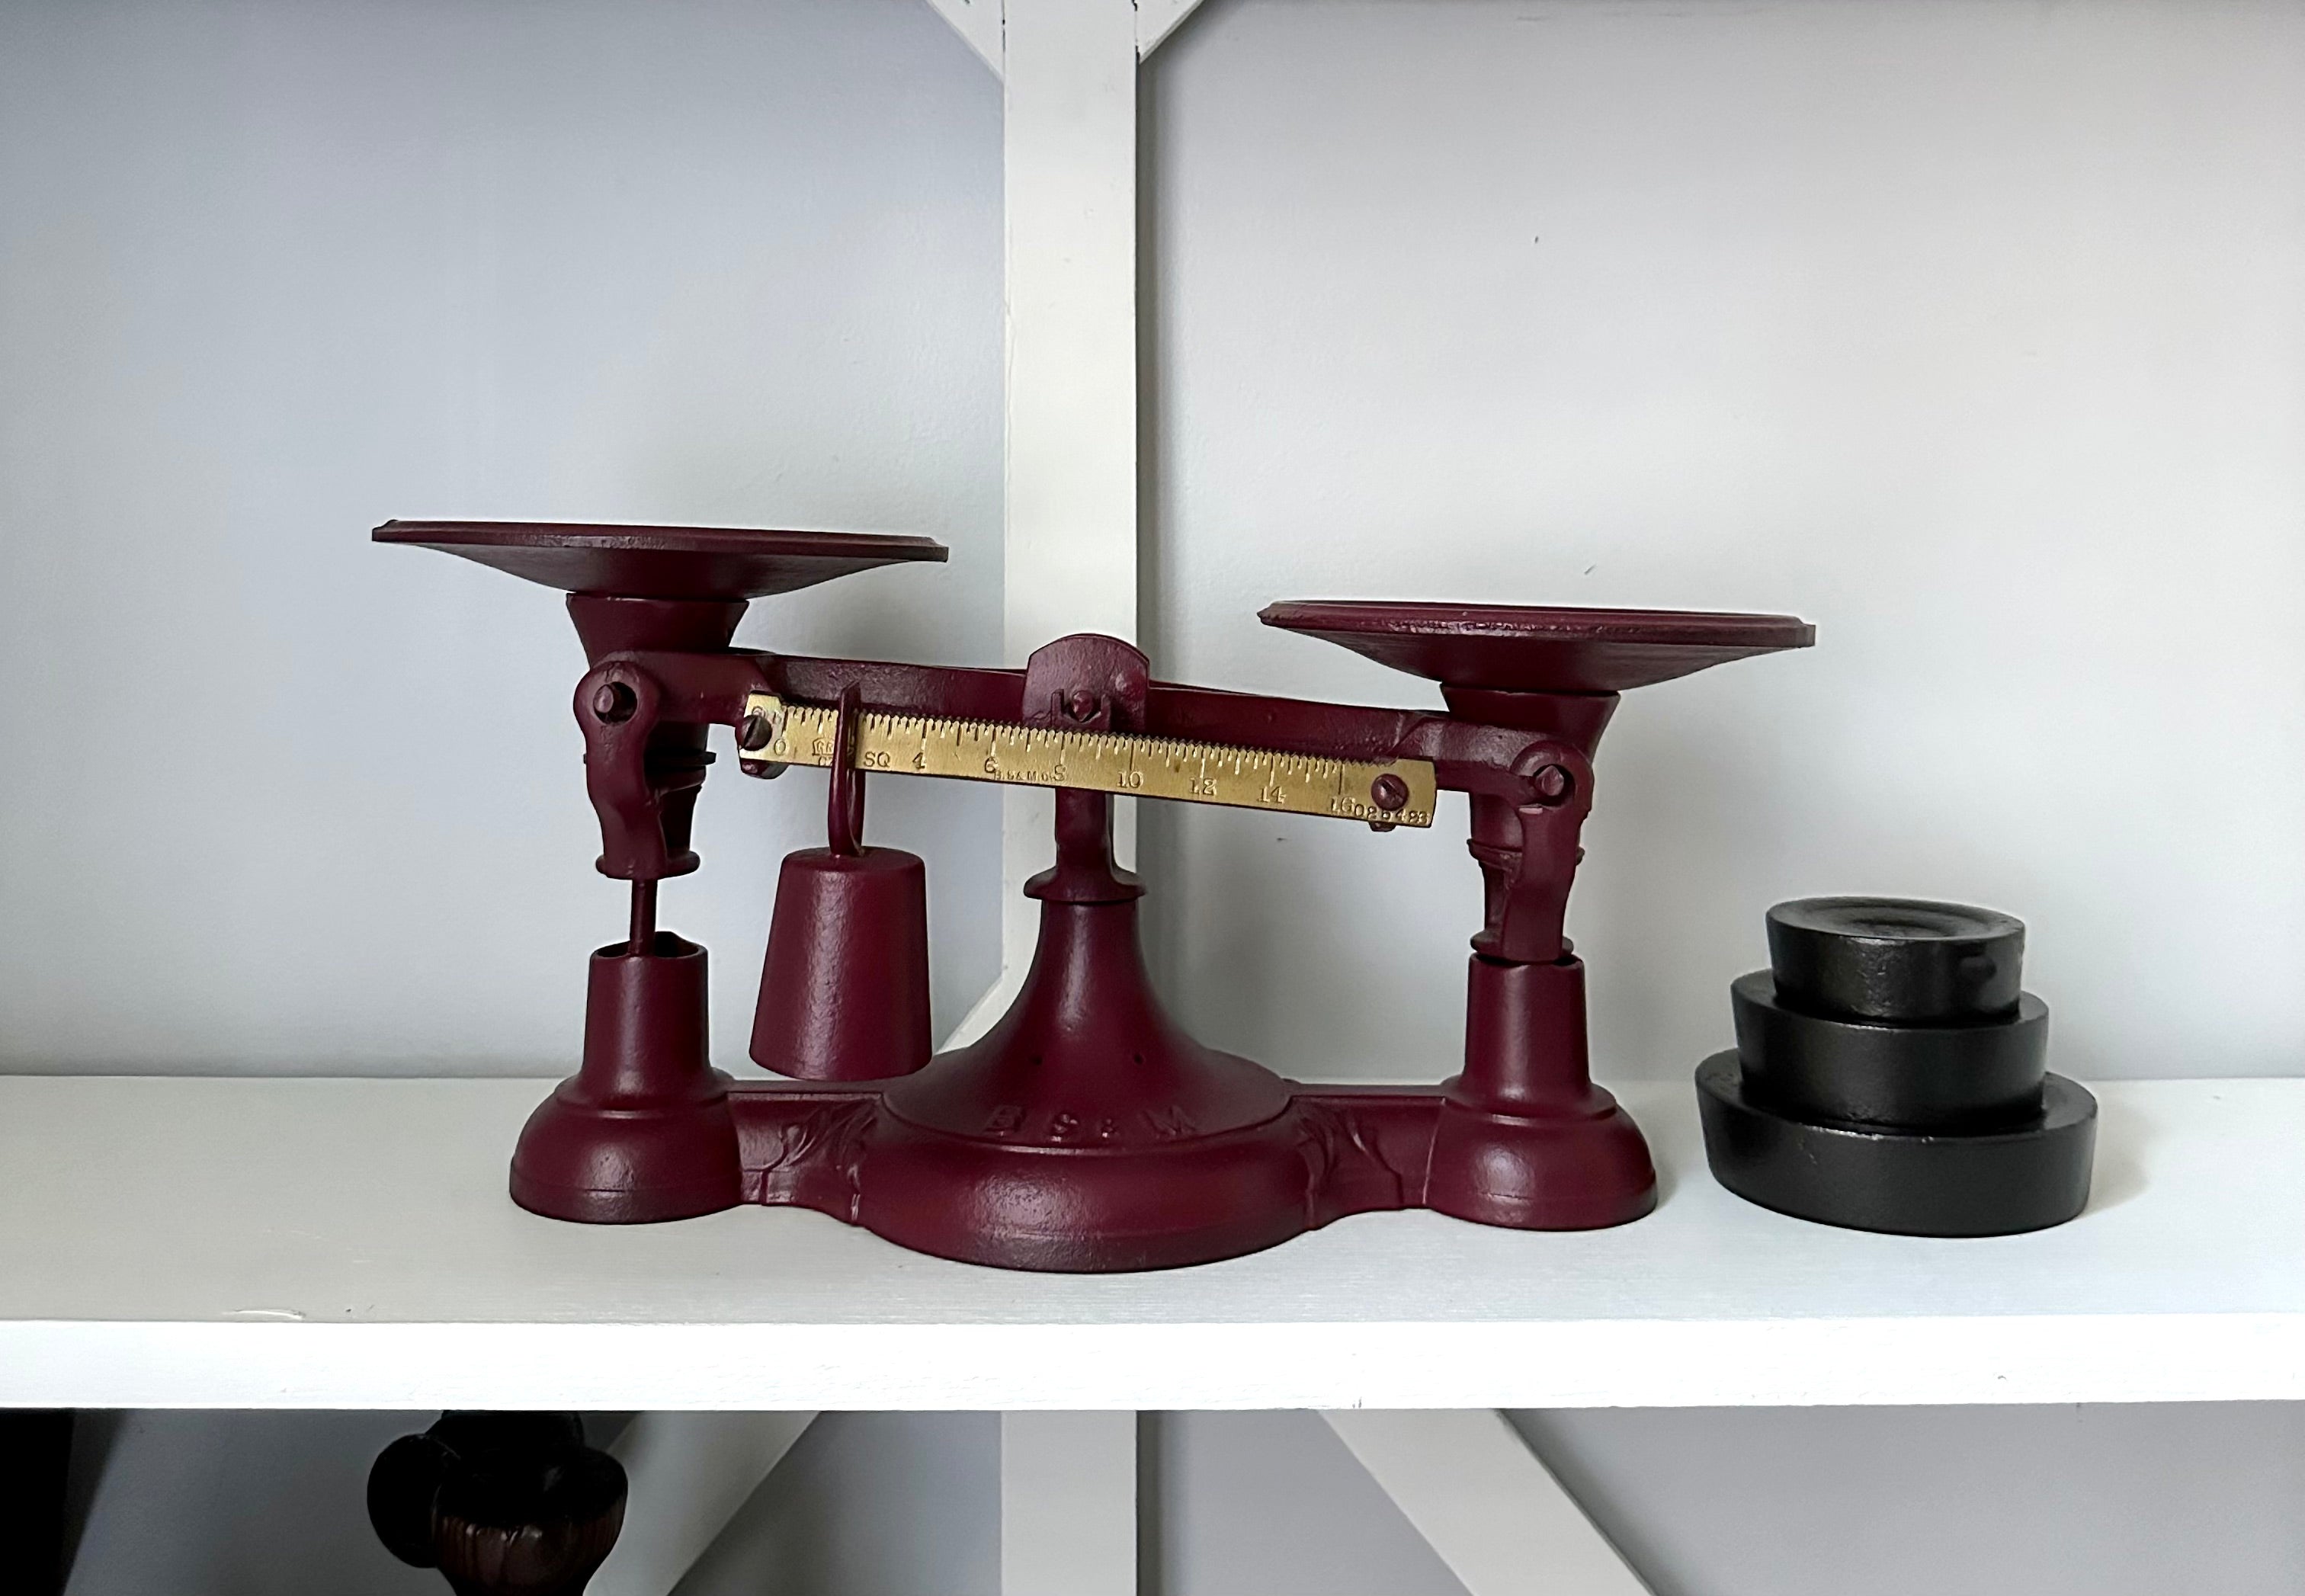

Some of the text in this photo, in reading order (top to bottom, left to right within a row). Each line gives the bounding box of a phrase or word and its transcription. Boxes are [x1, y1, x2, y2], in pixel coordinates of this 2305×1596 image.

[864, 753, 890, 768] SQ
[912, 752, 925, 769] 4
[984, 756, 999, 774] 6
[1117, 770, 1143, 788] 10
[1191, 777, 1217, 796] 12
[1259, 787, 1286, 804] 14
[1331, 796, 1355, 812] 16
